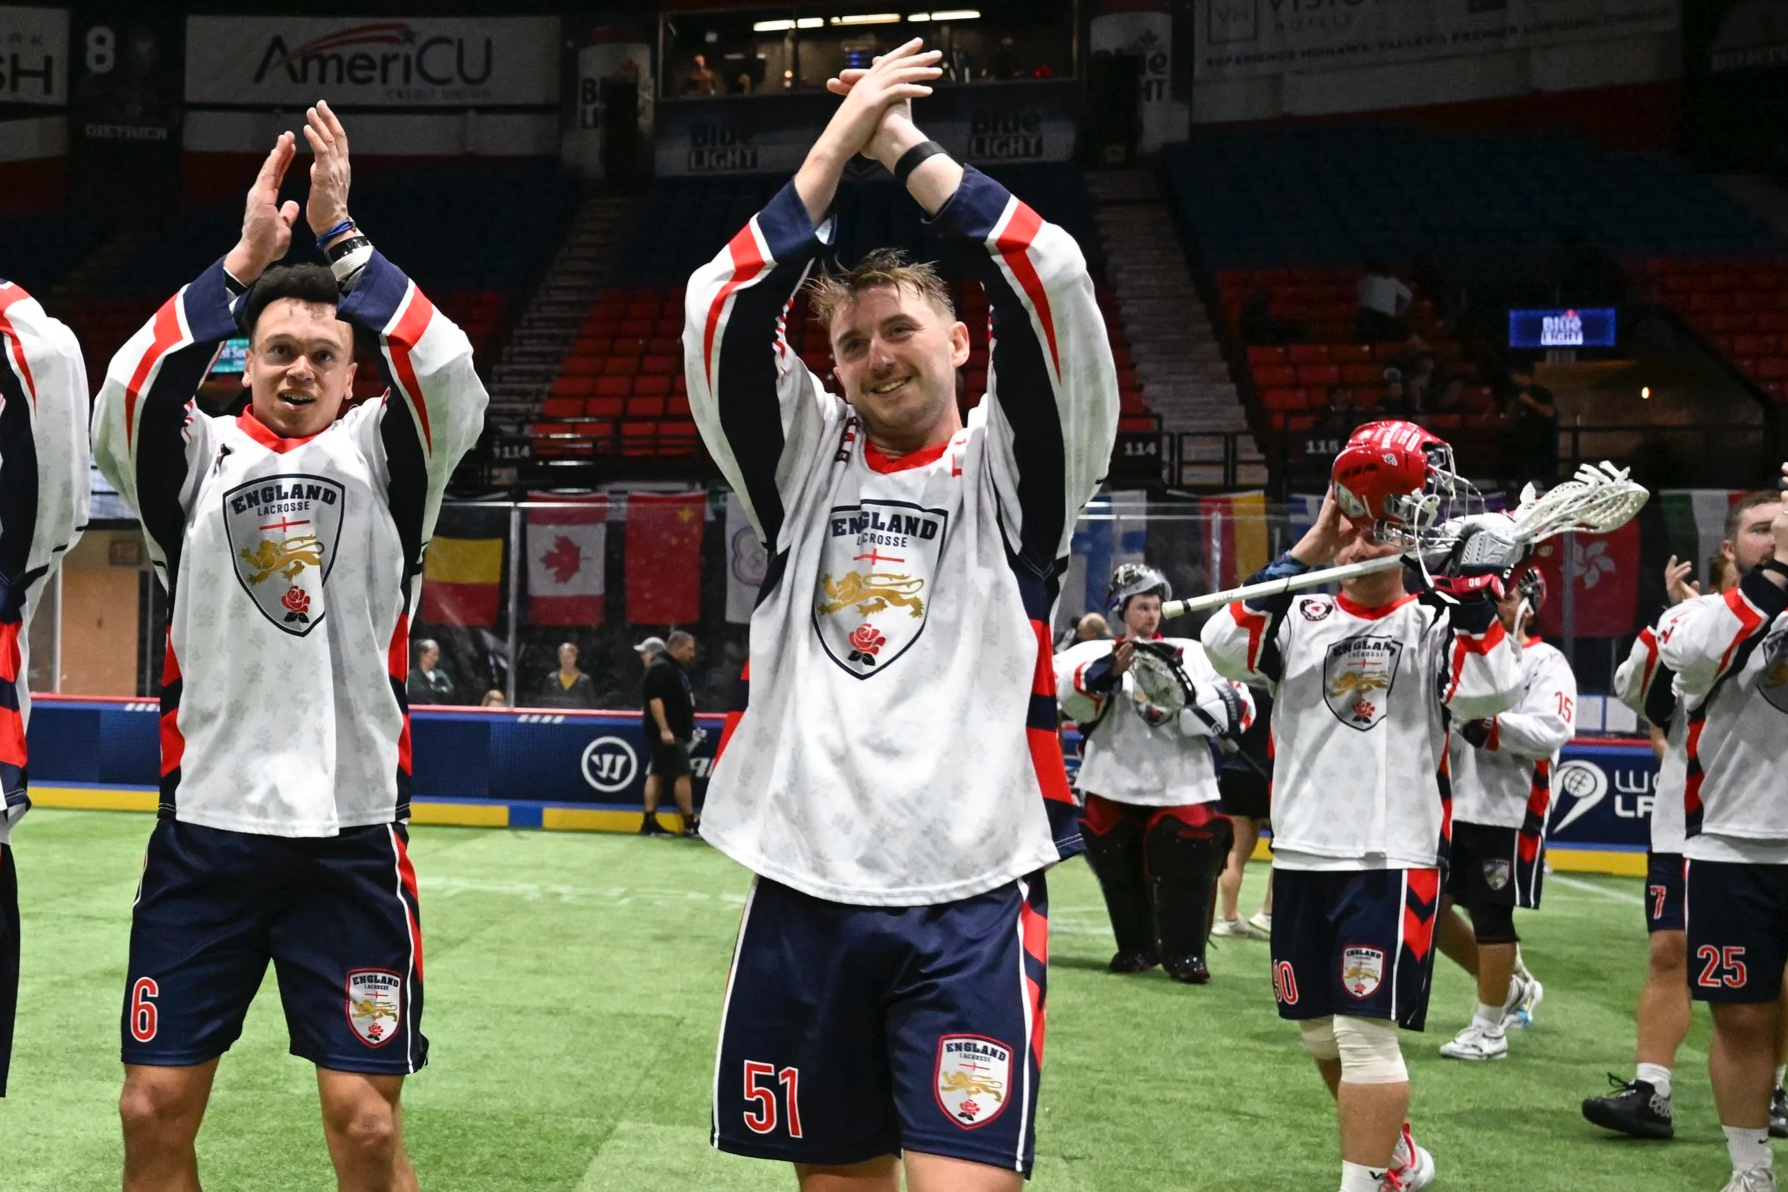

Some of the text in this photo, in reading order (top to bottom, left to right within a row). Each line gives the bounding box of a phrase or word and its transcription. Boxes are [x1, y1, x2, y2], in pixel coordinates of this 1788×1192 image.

[86, 26, 116, 74] 8
[252, 34, 493, 86] AmeriCU
[968, 134, 1043, 159] LIGHT
[688, 148, 758, 171] LIGHT
[1542, 315, 1582, 331] Blue
[1541, 330, 1583, 346] LIGHT
[1124, 441, 1156, 456] 114
[231, 483, 337, 516] ENGLAND
[257, 501, 310, 517] LACROSSE
[831, 510, 938, 540] ENGLAND
[857, 532, 907, 548] LCROSSE
[1650, 885, 1667, 920] 7
[1697, 945, 1747, 988] 25
[352, 974, 399, 988] ENGLAND
[130, 976, 159, 1043] 6
[946, 1041, 1007, 1062] ENGLAND
[743, 1059, 803, 1139] 51
